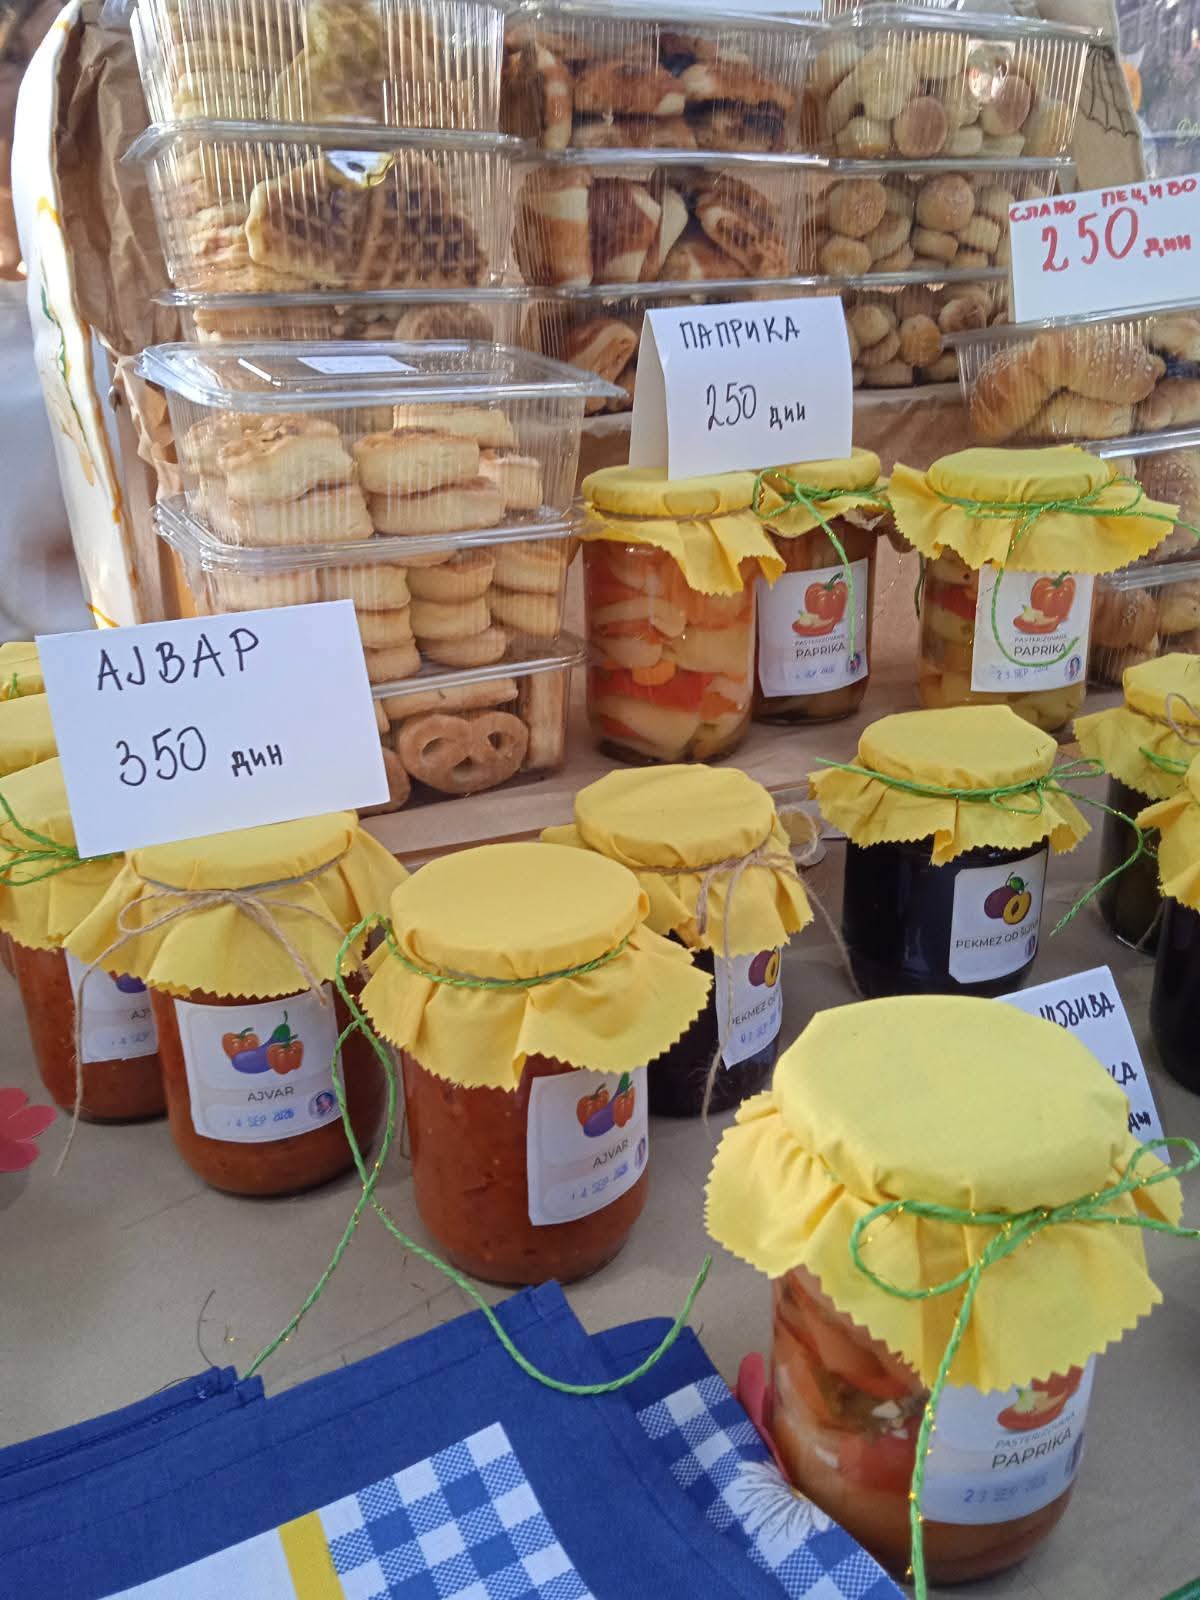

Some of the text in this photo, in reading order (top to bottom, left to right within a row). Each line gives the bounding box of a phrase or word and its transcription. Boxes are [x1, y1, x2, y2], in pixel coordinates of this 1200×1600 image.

[1101, 178, 1197, 208] ПЕЦИВО
[1041, 206, 1139, 272] 250
[679, 316, 801, 350] ПАПРИКА
[706, 382, 757, 431] 250
[97, 628, 260, 691] АЈВАР
[796, 641, 845, 659] PAPRIKA
[1014, 643, 1067, 657] PAPRIKA
[116, 726, 206, 786] 350
[956, 935, 1003, 949] PEKMEZ
[1004, 930, 1019, 943] OD
[247, 1086, 295, 1102] AJVAR
[592, 1138, 629, 1169] AJVAR
[991, 1427, 1072, 1470] PAPRIKA
